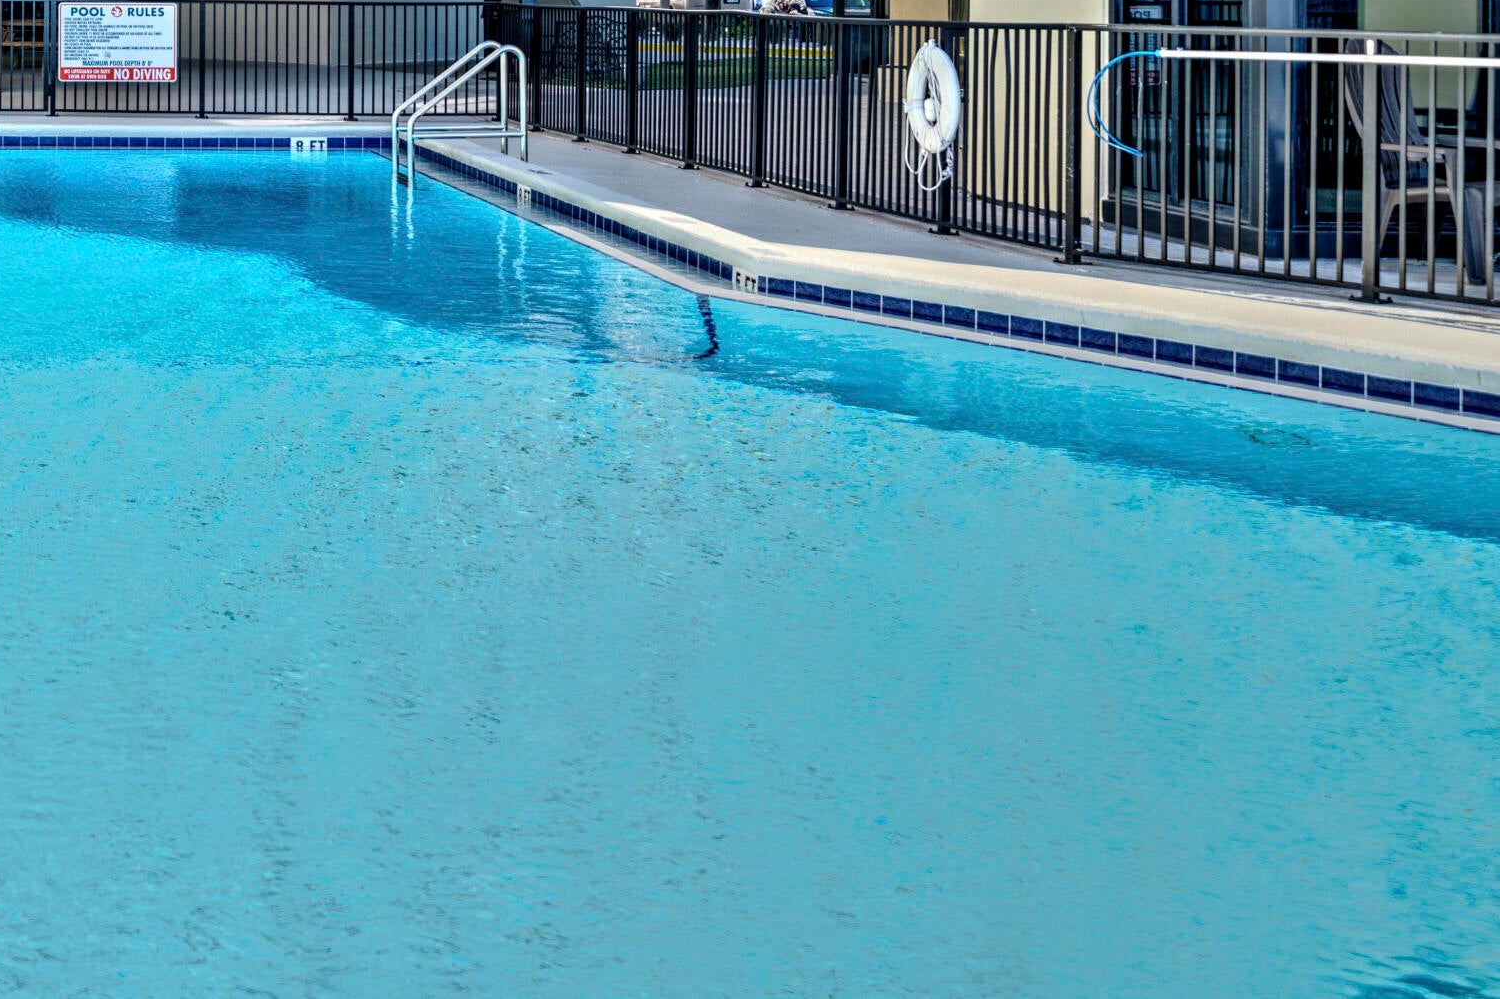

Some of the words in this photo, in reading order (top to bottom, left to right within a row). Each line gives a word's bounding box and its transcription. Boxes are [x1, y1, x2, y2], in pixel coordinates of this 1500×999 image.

[70, 7, 105, 17] POOL
[127, 7, 165, 17] RULES
[113, 68, 130, 80] NO
[133, 68, 171, 80] DIVING
[310, 140, 326, 150] FT
